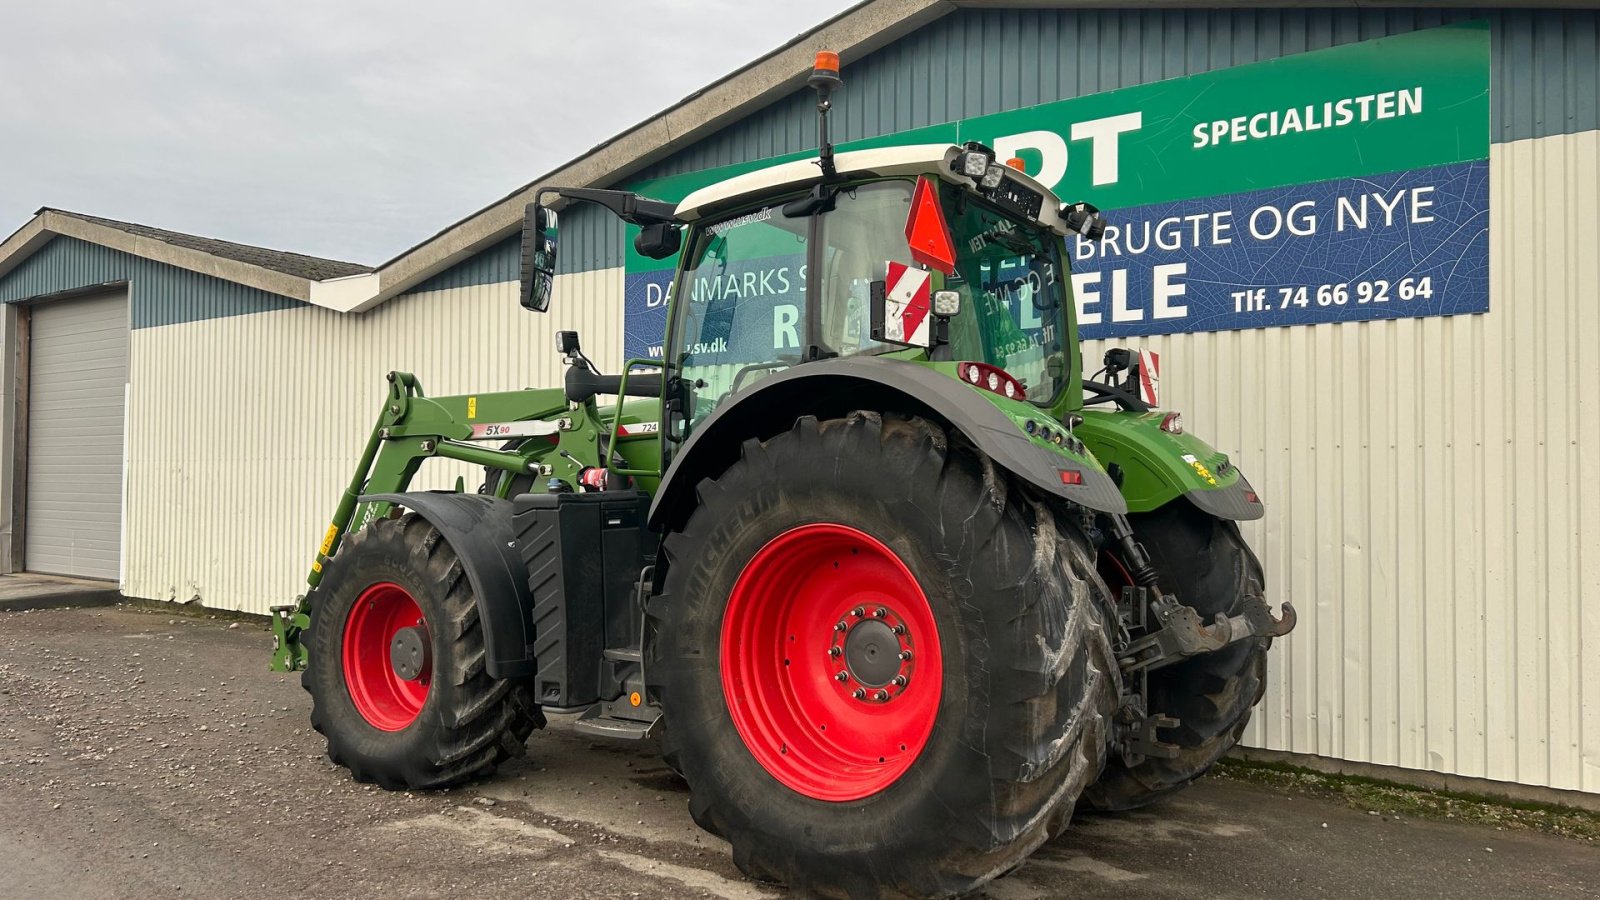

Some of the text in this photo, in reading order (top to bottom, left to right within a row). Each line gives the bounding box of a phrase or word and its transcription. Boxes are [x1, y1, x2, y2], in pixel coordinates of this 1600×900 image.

[1193, 87, 1422, 148] SPECIALISTEN
[705, 206, 773, 236] www.usv.dk
[1076, 210, 1232, 260] BRUGTE
[1249, 201, 1316, 240] OG
[1337, 186, 1434, 232] NYE
[1232, 289, 1271, 313] Tlf.
[1279, 287, 1309, 309] 74
[1317, 284, 1348, 306] 66
[1357, 280, 1389, 303] 92
[1399, 277, 1433, 300] 64
[642, 423, 657, 432] 724
